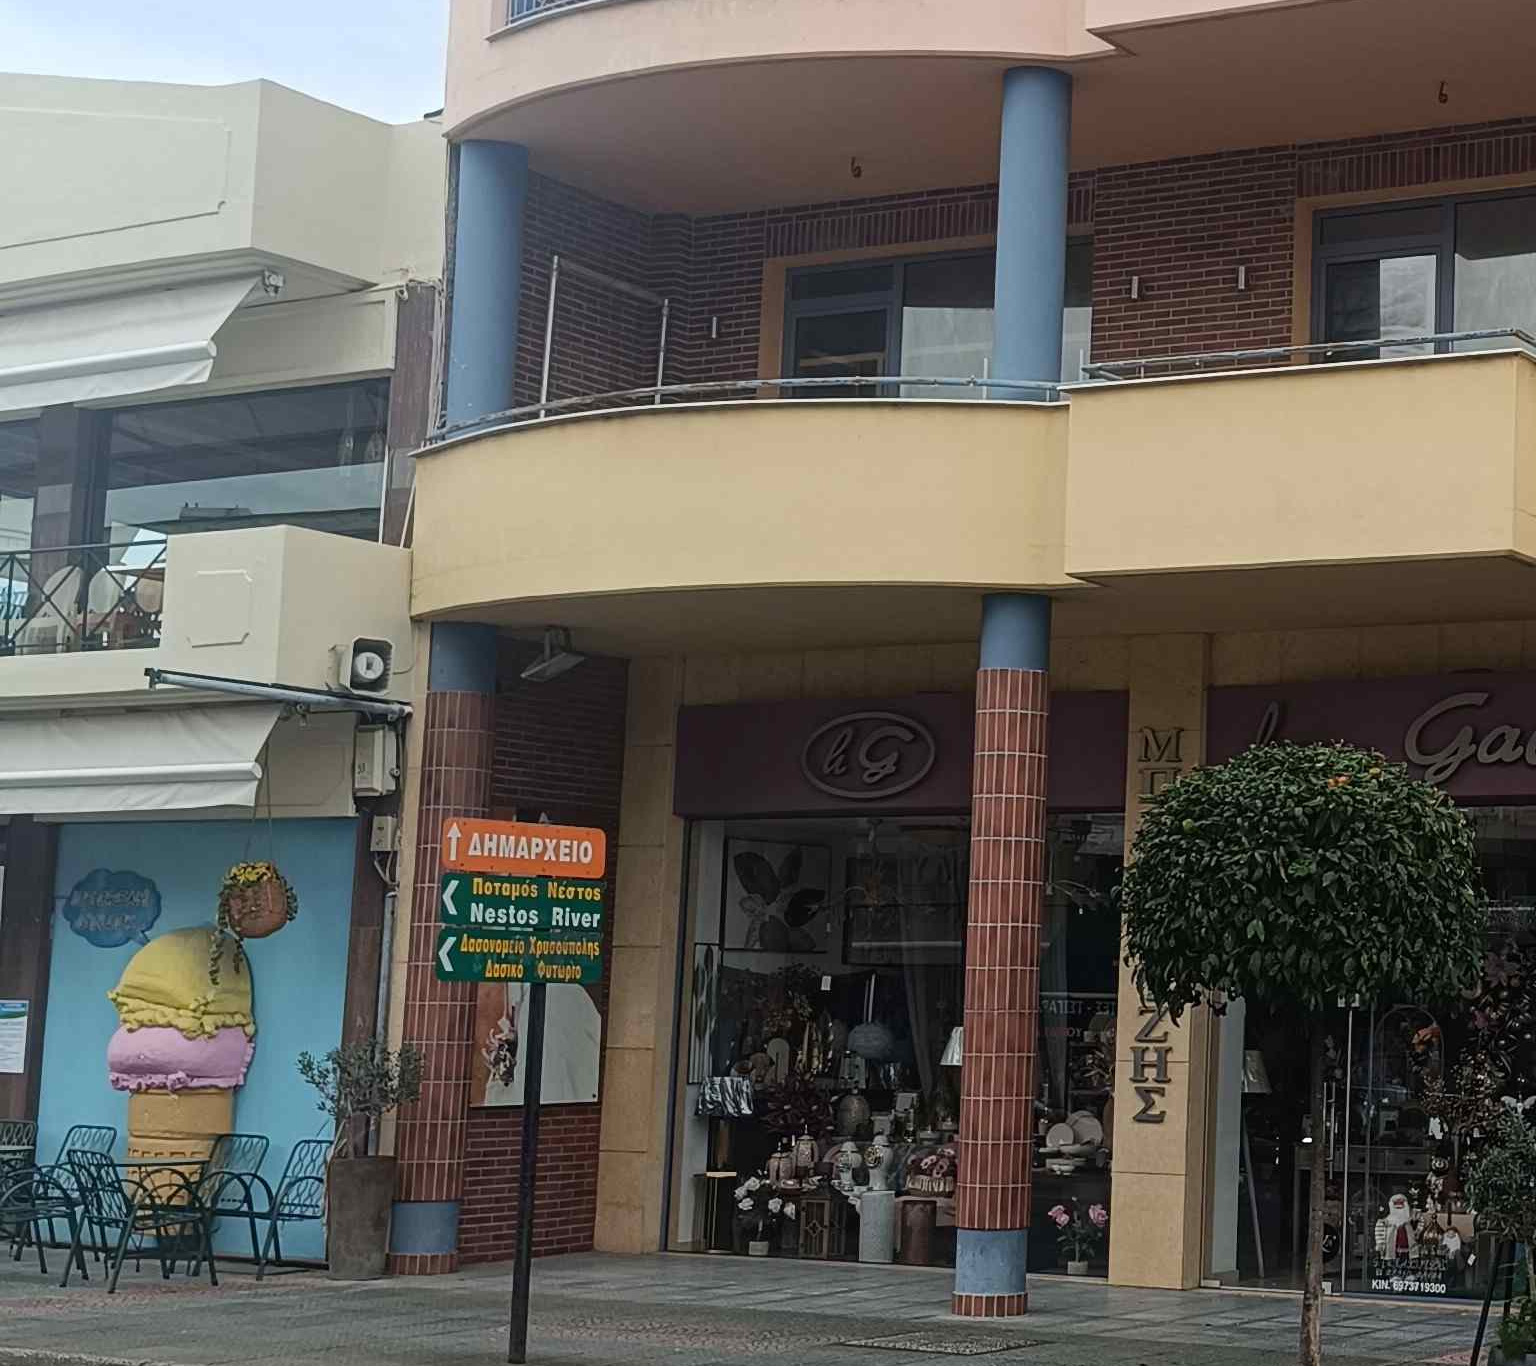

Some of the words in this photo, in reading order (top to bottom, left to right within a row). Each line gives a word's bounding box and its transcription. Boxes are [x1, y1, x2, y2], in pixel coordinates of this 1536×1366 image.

[468, 833, 593, 864] ΔΗΜΑΡΧΕΙΟ
[472, 877, 538, 900] Ποταμός
[547, 880, 601, 901] Νέστος
[470, 903, 539, 924] Nestos
[551, 907, 601, 928] River
[485, 959, 524, 979] Δασικό
